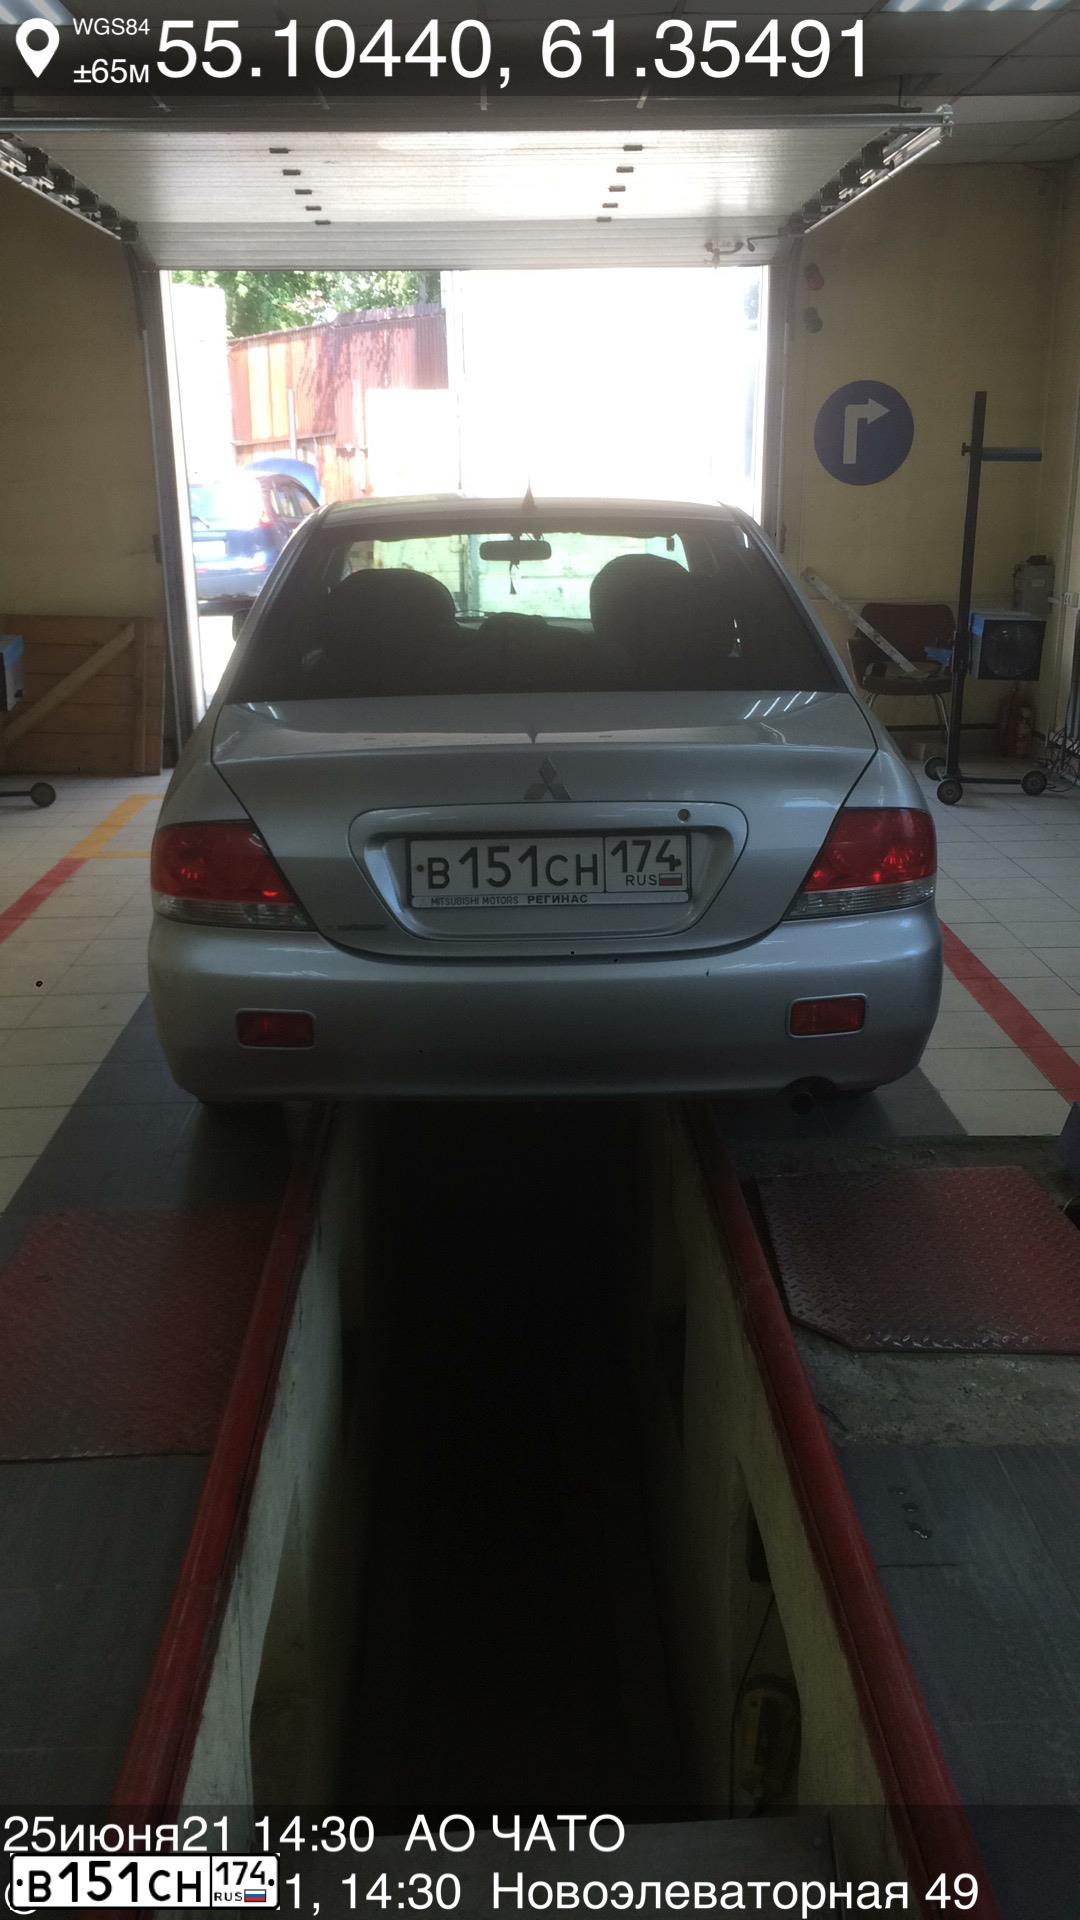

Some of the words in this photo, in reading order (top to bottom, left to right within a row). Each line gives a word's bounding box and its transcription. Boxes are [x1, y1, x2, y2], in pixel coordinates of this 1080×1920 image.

[610, 839, 675, 873] 174
[625, 873, 658, 886] RUS
[431, 896, 480, 905] MITSUBISHI
[481, 895, 519, 905] MOTORS
[527, 894, 589, 904] РЕГИНАС
